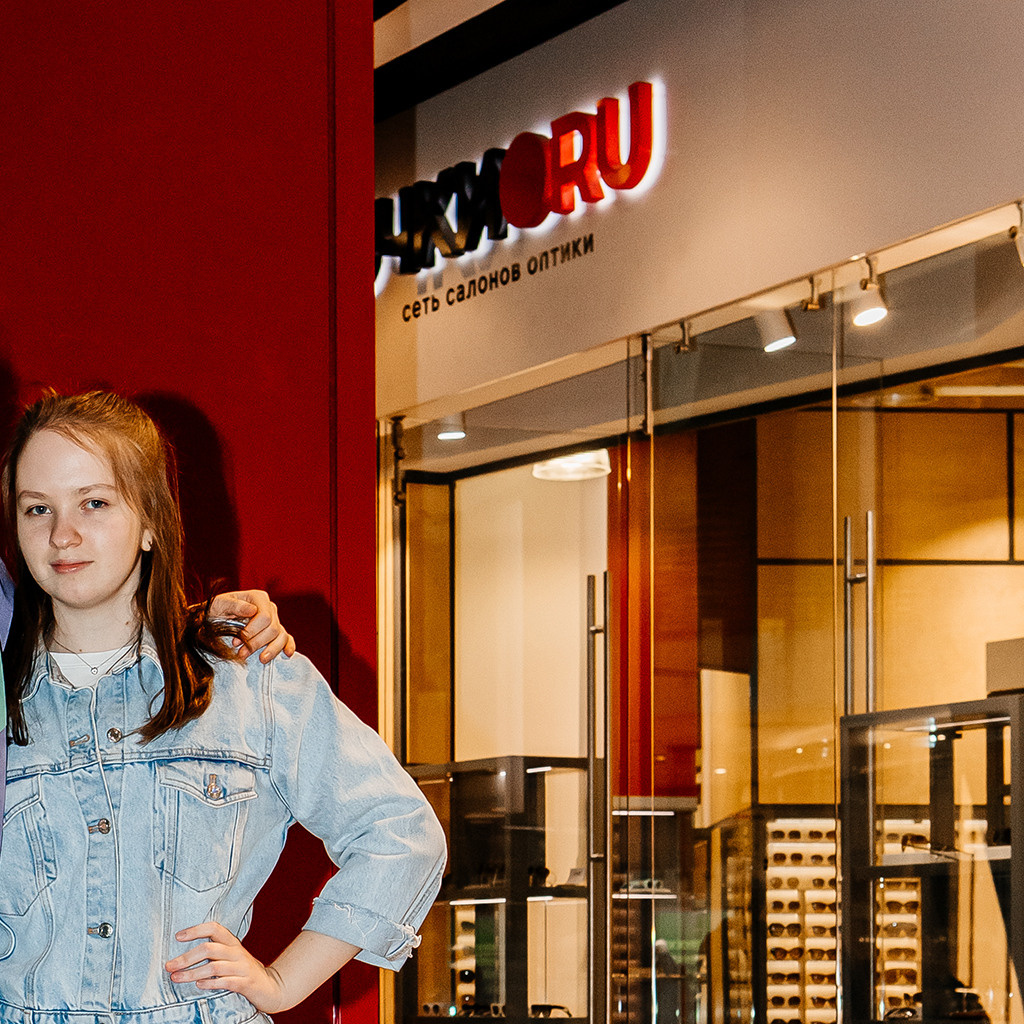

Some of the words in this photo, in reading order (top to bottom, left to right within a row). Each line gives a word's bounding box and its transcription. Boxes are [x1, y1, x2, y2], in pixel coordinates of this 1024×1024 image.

[402, 295, 440, 322] сеть
[446, 263, 521, 306] салонов
[527, 233, 594, 275] оптики
